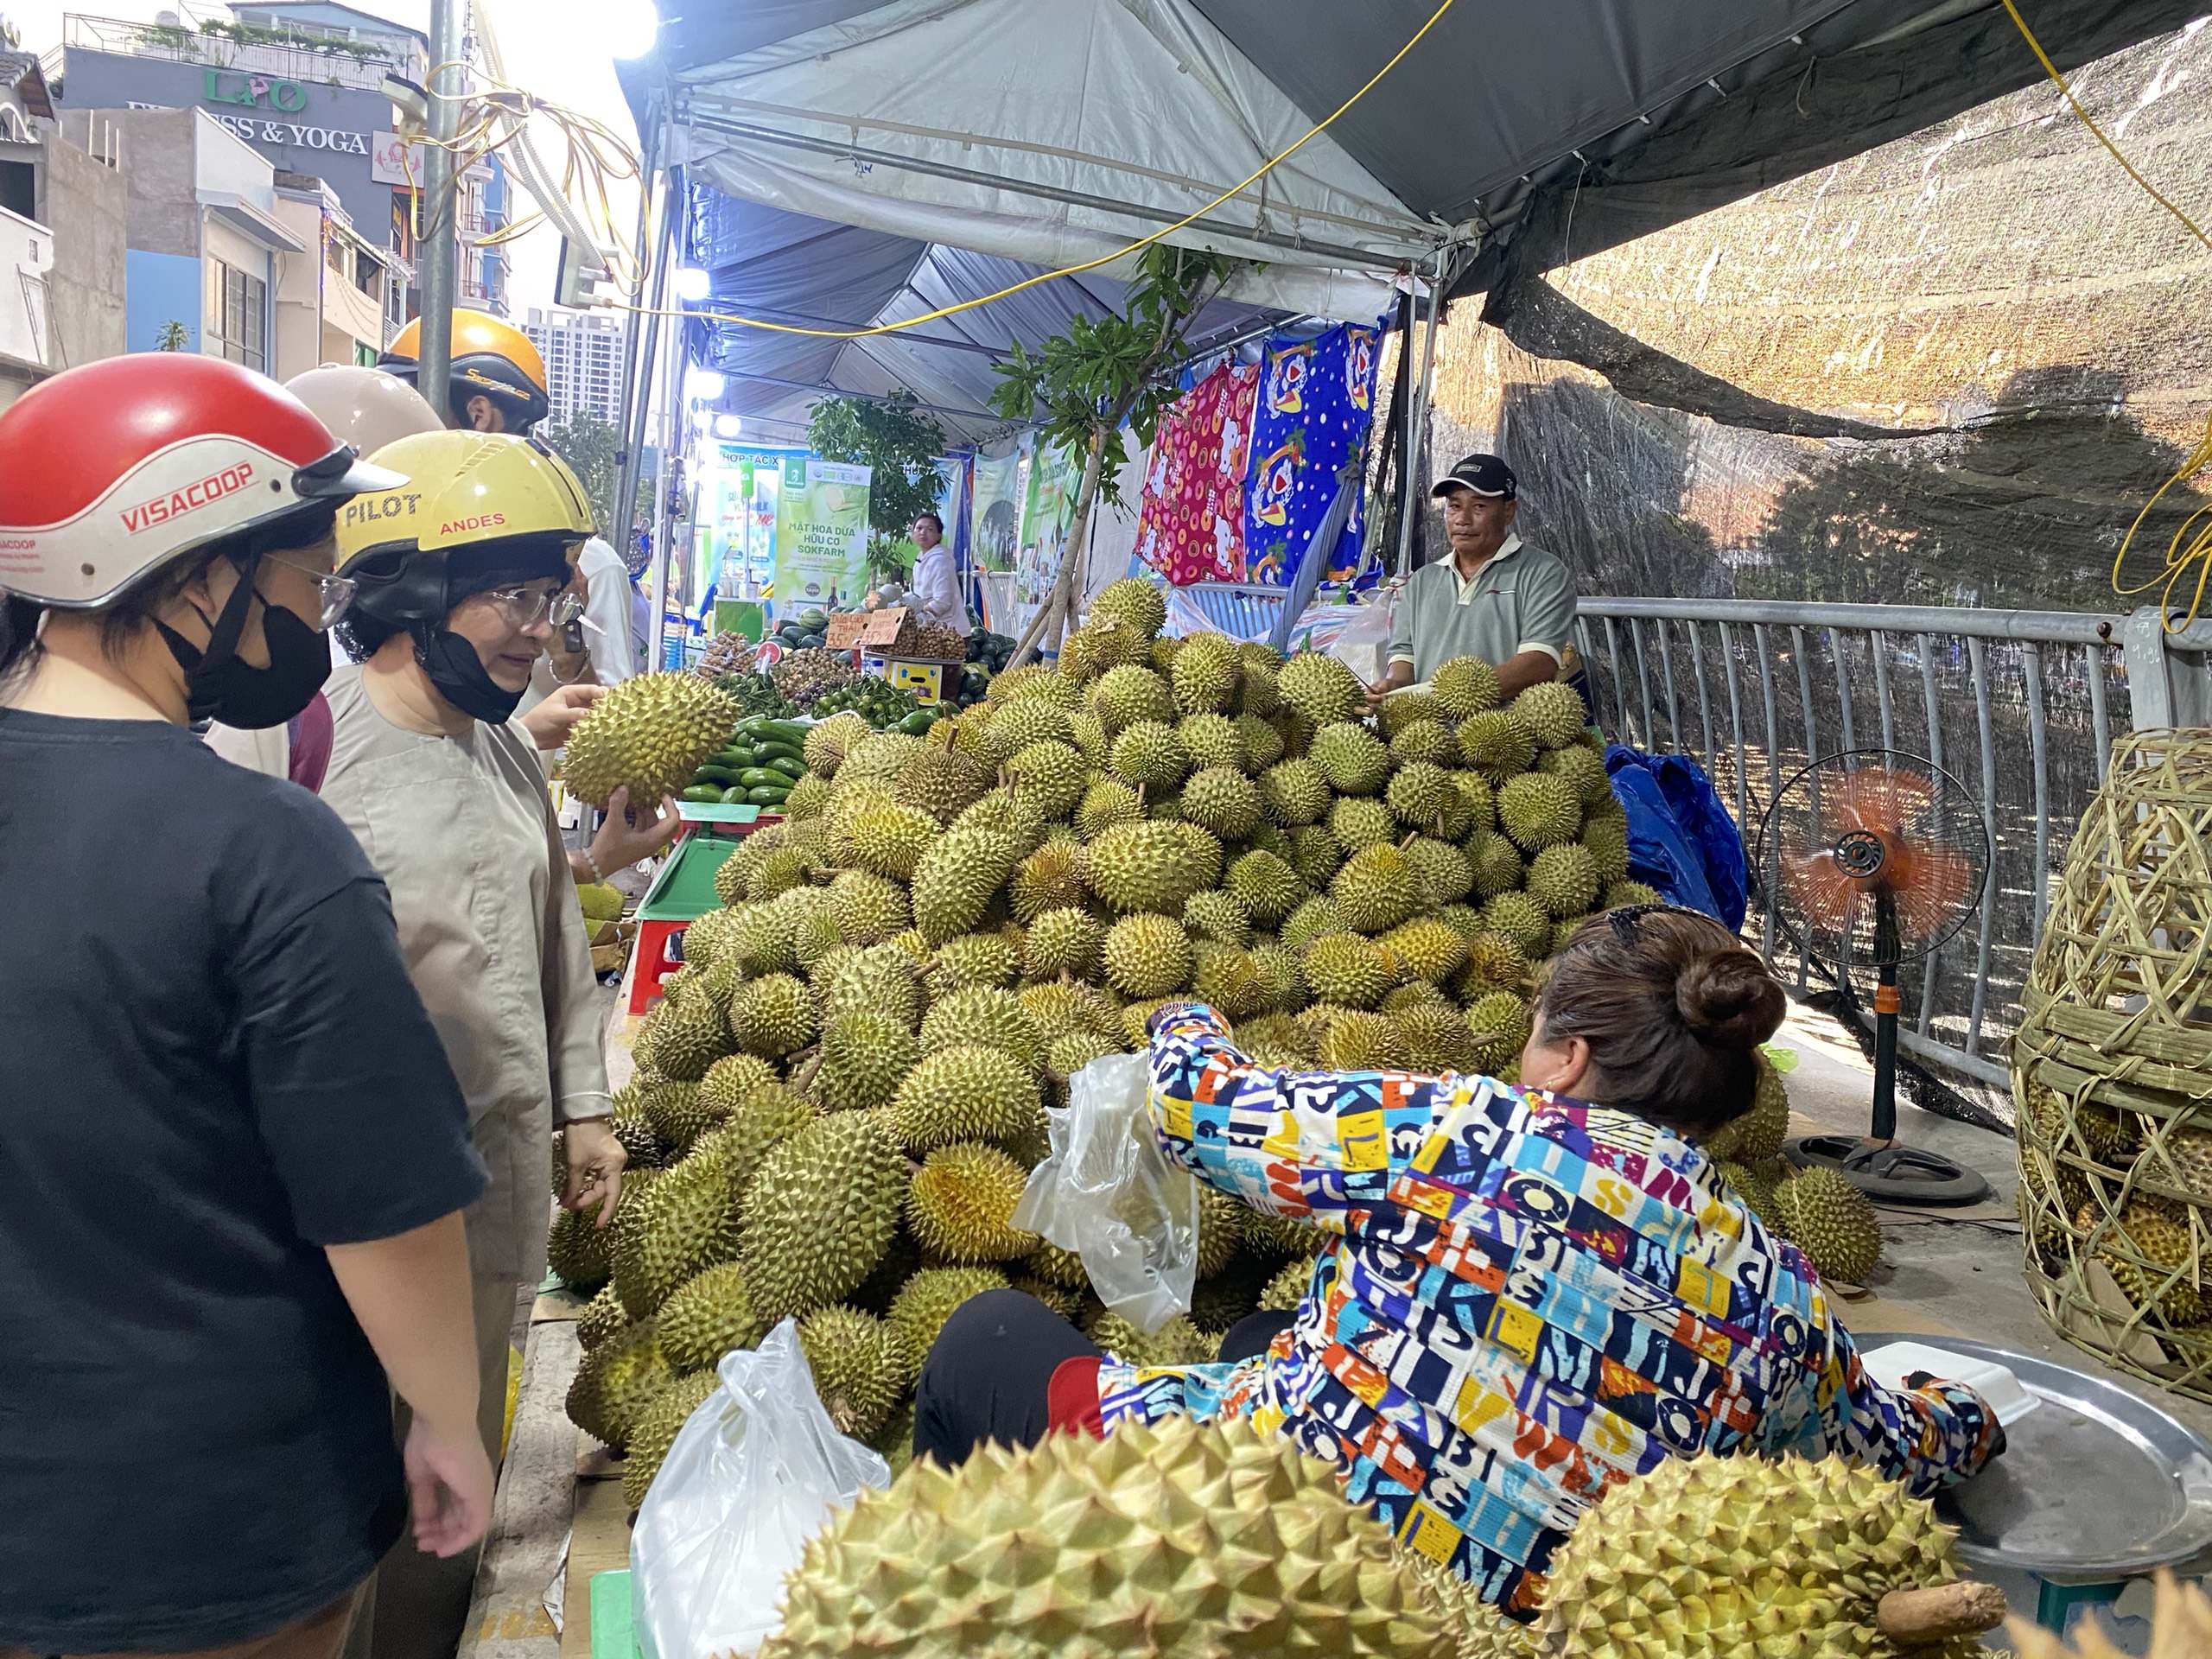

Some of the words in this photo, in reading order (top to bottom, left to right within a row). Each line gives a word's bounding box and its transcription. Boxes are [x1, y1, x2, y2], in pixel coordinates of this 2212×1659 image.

[261, 121, 284, 143] &
[288, 124, 369, 155] YOGA
[120, 463, 253, 531] VISACOOP
[346, 494, 422, 528] PILOT
[440, 513, 505, 536] ANDES
[788, 521, 810, 534] MẬT
[812, 524, 833, 535] HOA
[835, 525, 855, 537] DỪA
[798, 544, 845, 557] SOKFARM
[804, 533, 825, 544] HỮU
[826, 537, 840, 546] CƠ
